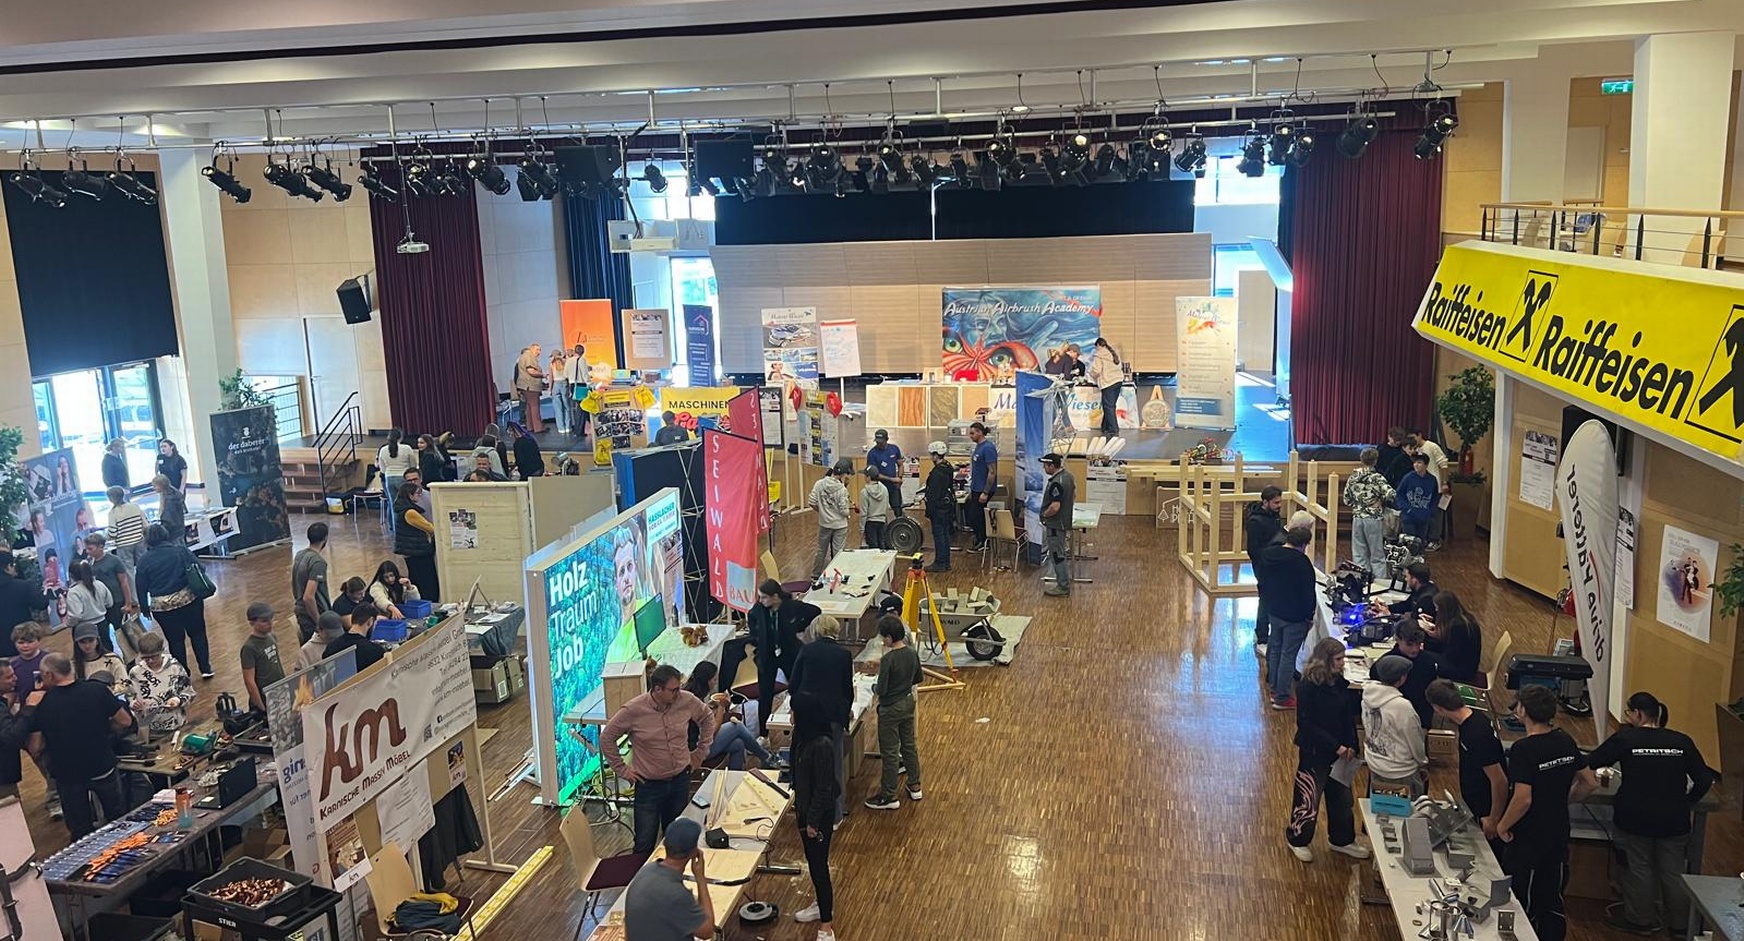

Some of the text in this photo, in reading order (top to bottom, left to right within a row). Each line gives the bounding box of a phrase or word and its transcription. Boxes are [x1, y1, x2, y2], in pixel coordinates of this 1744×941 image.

[944, 301, 1094, 316] Austrian Airbrush Academy
[1421, 282, 1506, 350] Raiffeisen
[1532, 315, 1694, 419] Raiffeisen
[711, 434, 724, 599] SEIWALD
[549, 561, 588, 607] Holz
[730, 585, 754, 603] BAU
[551, 590, 598, 641] Traum
[555, 633, 584, 679] Job
[319, 697, 407, 802] km
[319, 786, 360, 820] KARNISCHE
[386, 750, 410, 771] MÖBEL
[218, 917, 236, 928] STIER
